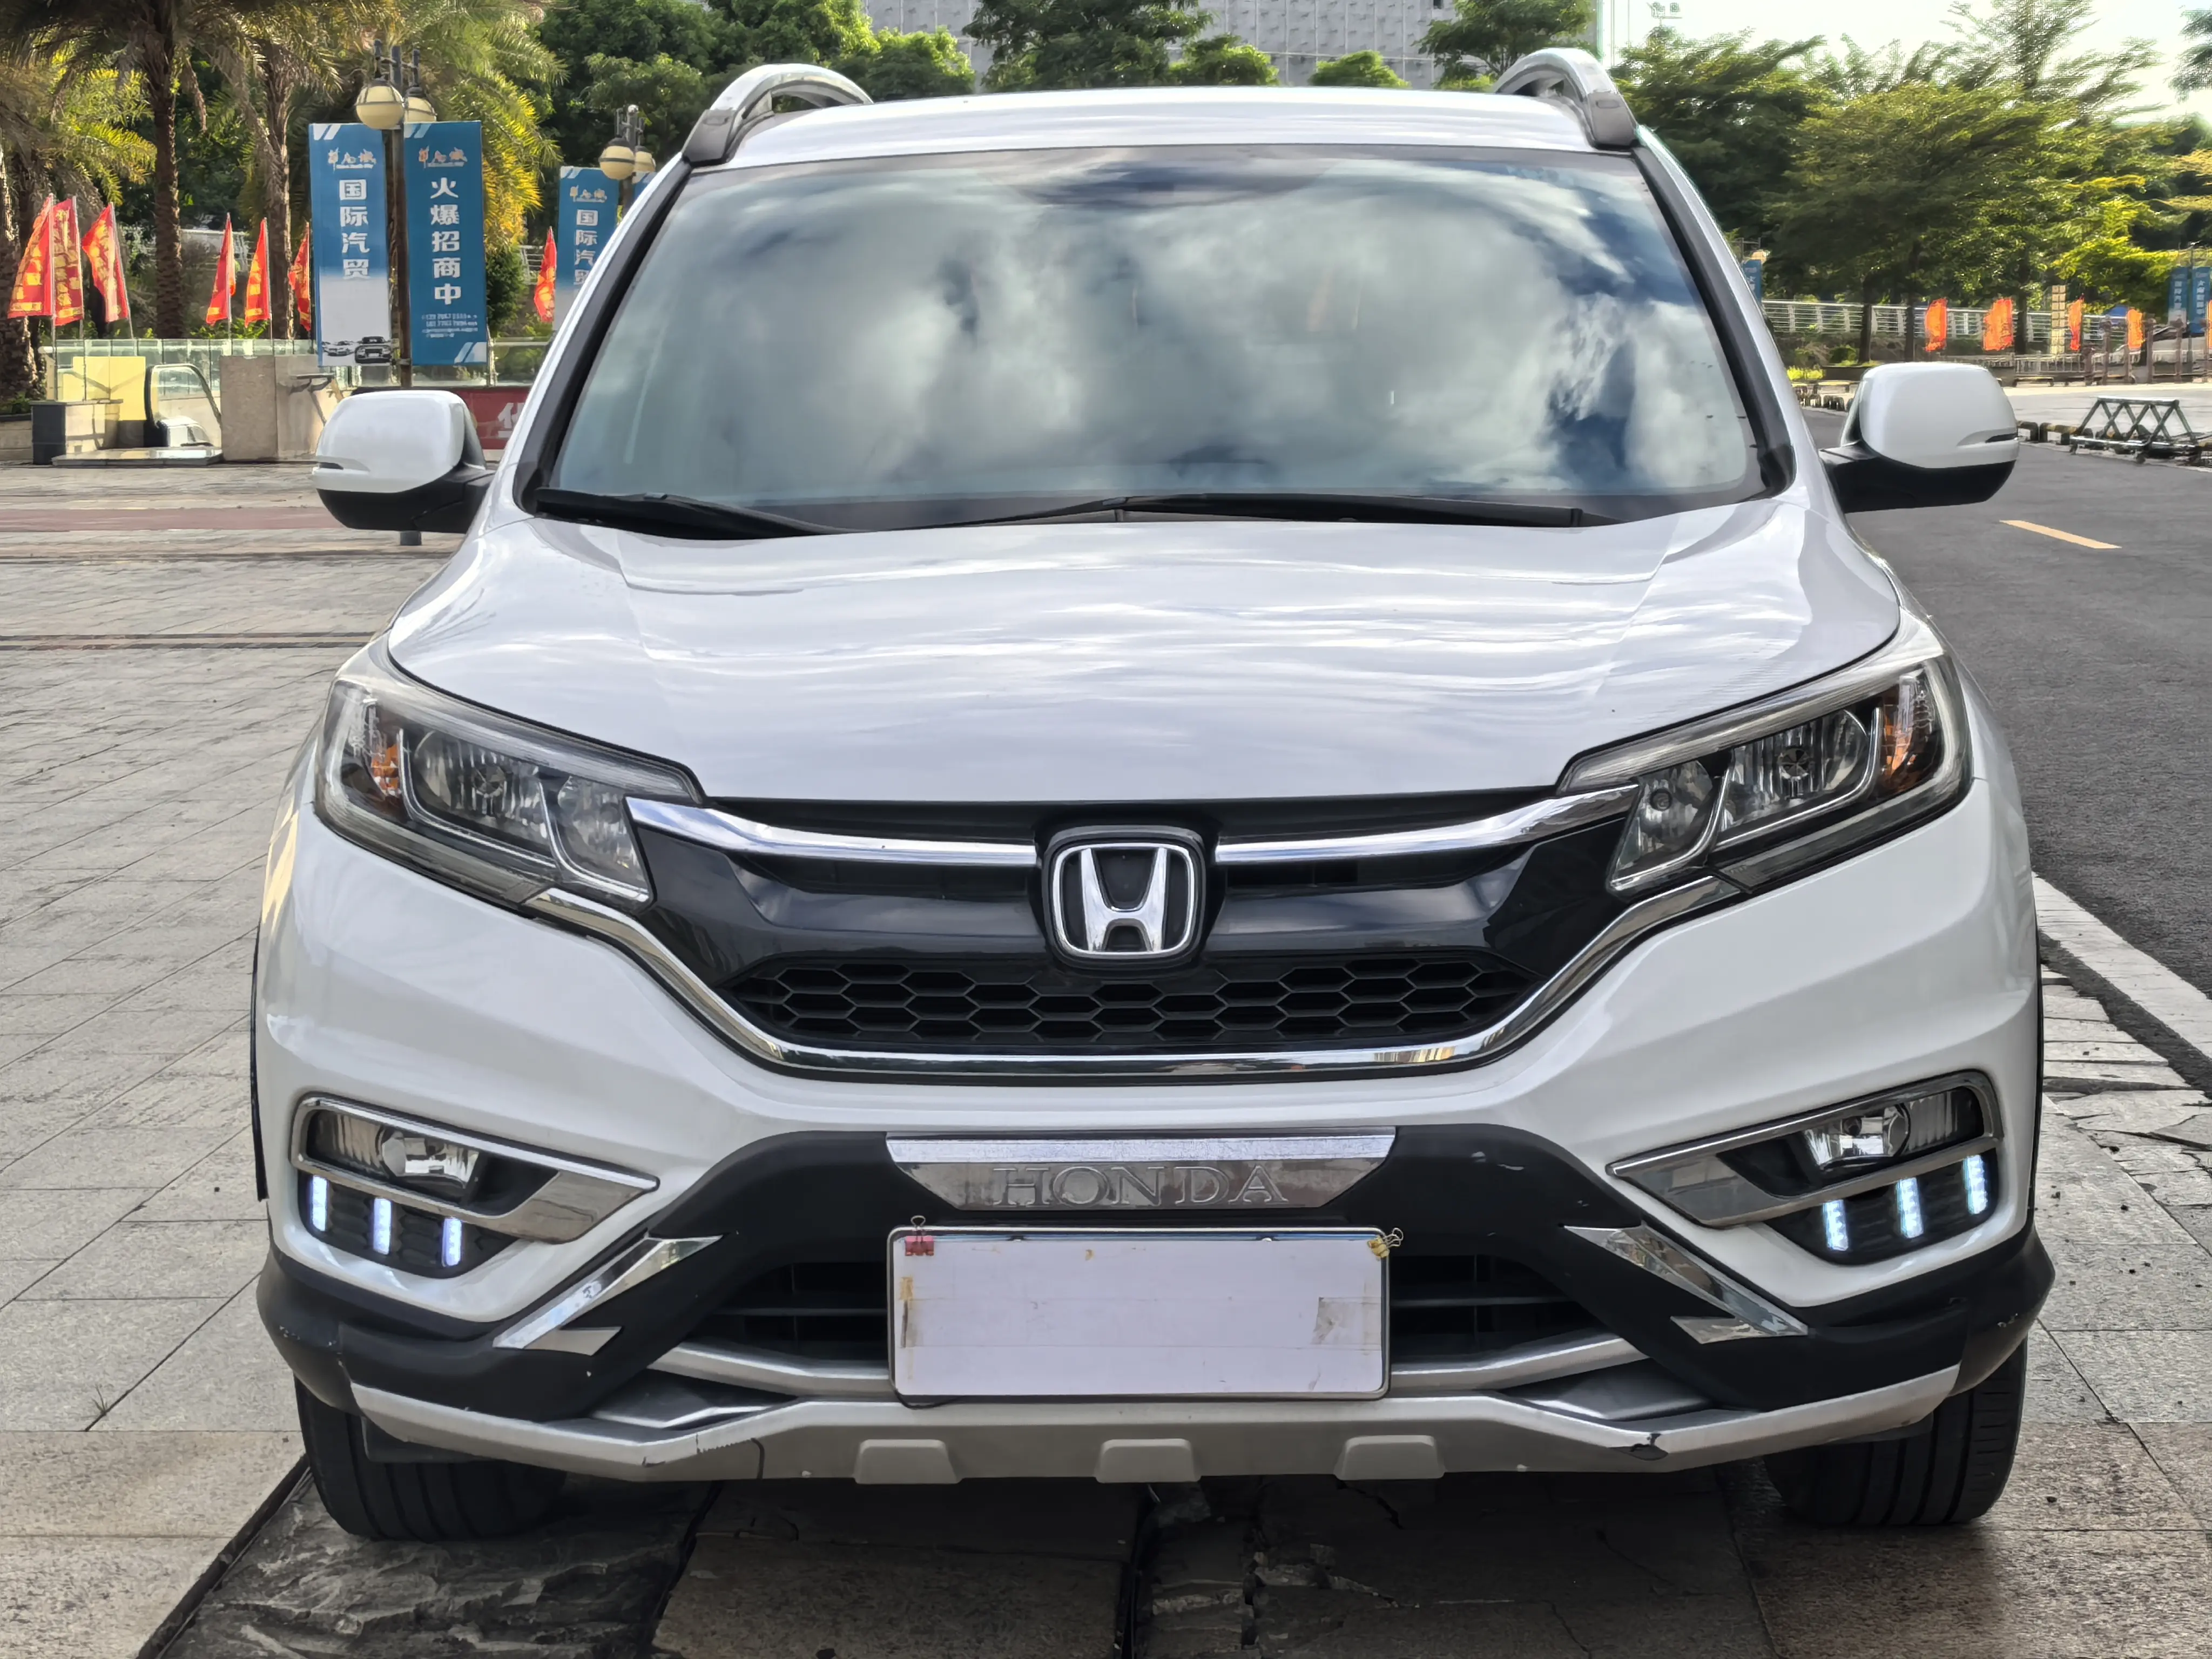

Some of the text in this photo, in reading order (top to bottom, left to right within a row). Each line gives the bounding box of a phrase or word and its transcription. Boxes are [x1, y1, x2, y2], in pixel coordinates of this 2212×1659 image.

[339, 179, 370, 280] 国际汽贸
[430, 177, 461, 305] 火爆招商中
[992, 1165, 1290, 1206] HONDA
